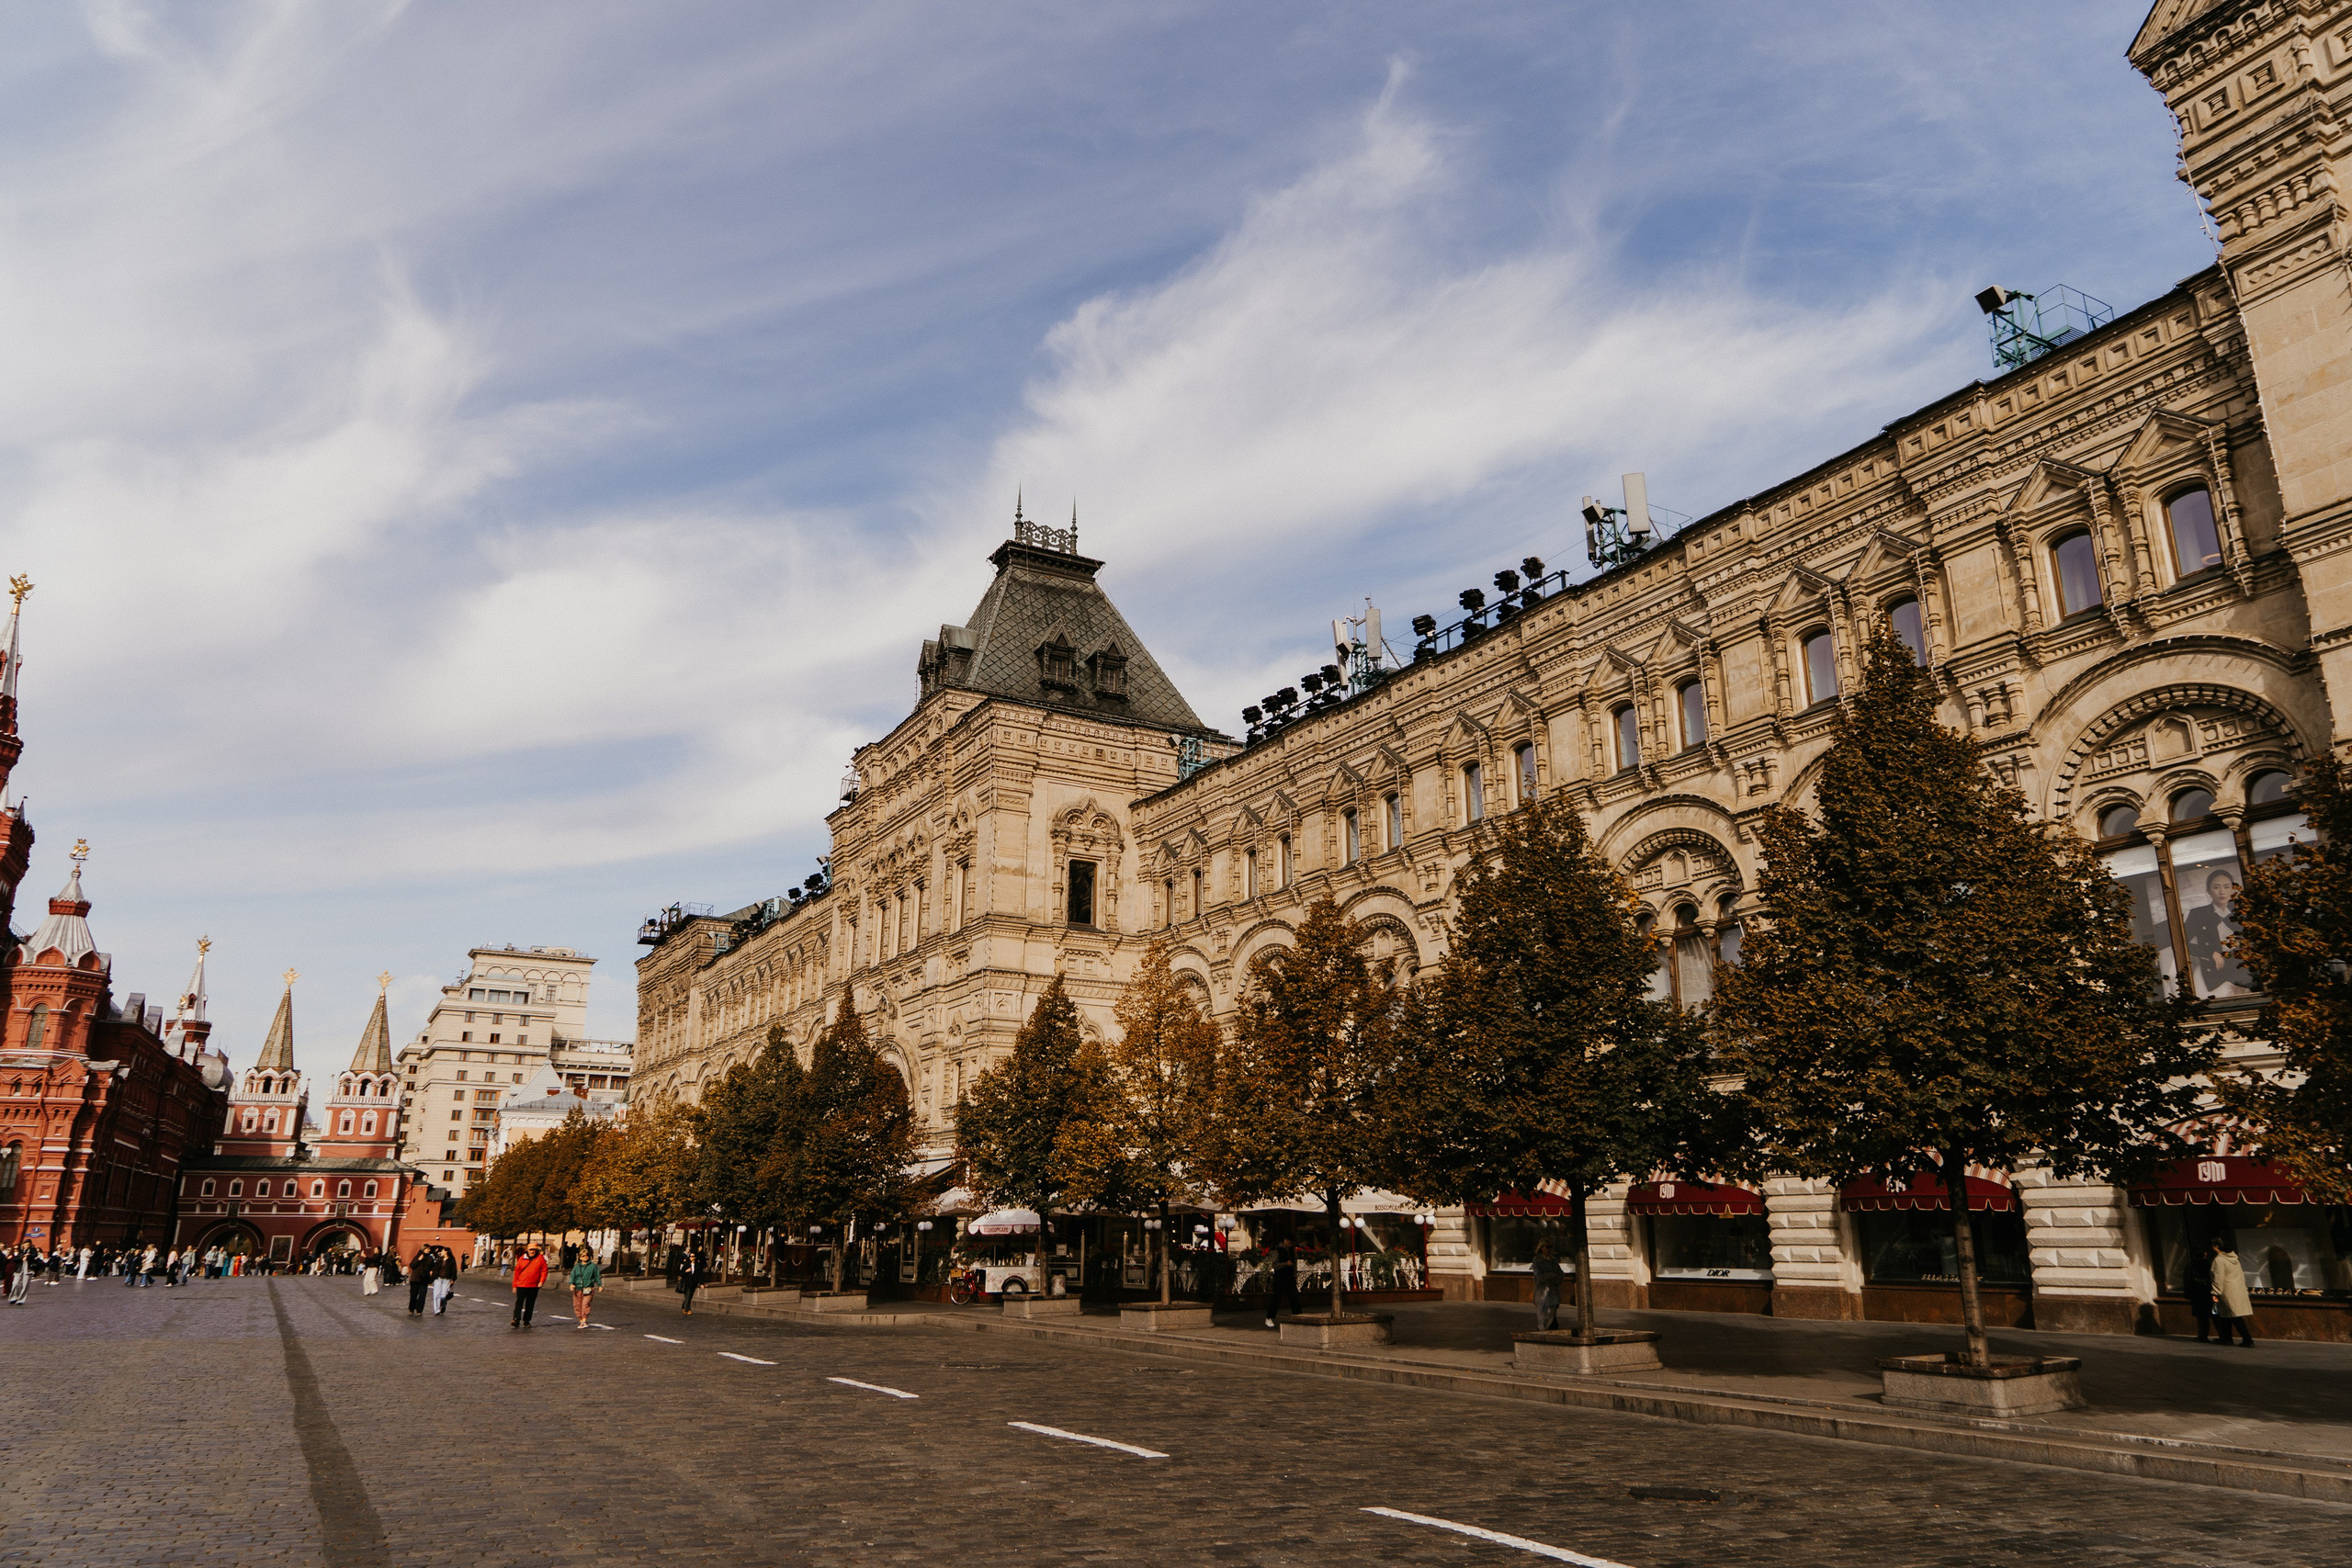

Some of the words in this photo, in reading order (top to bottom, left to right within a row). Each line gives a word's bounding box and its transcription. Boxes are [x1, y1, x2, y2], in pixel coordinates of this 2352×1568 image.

[2198, 1160, 2226, 1182] ГУМ
[1706, 1269, 1730, 1278] DIOR
[1921, 1274, 1961, 1282] ELLASSA
